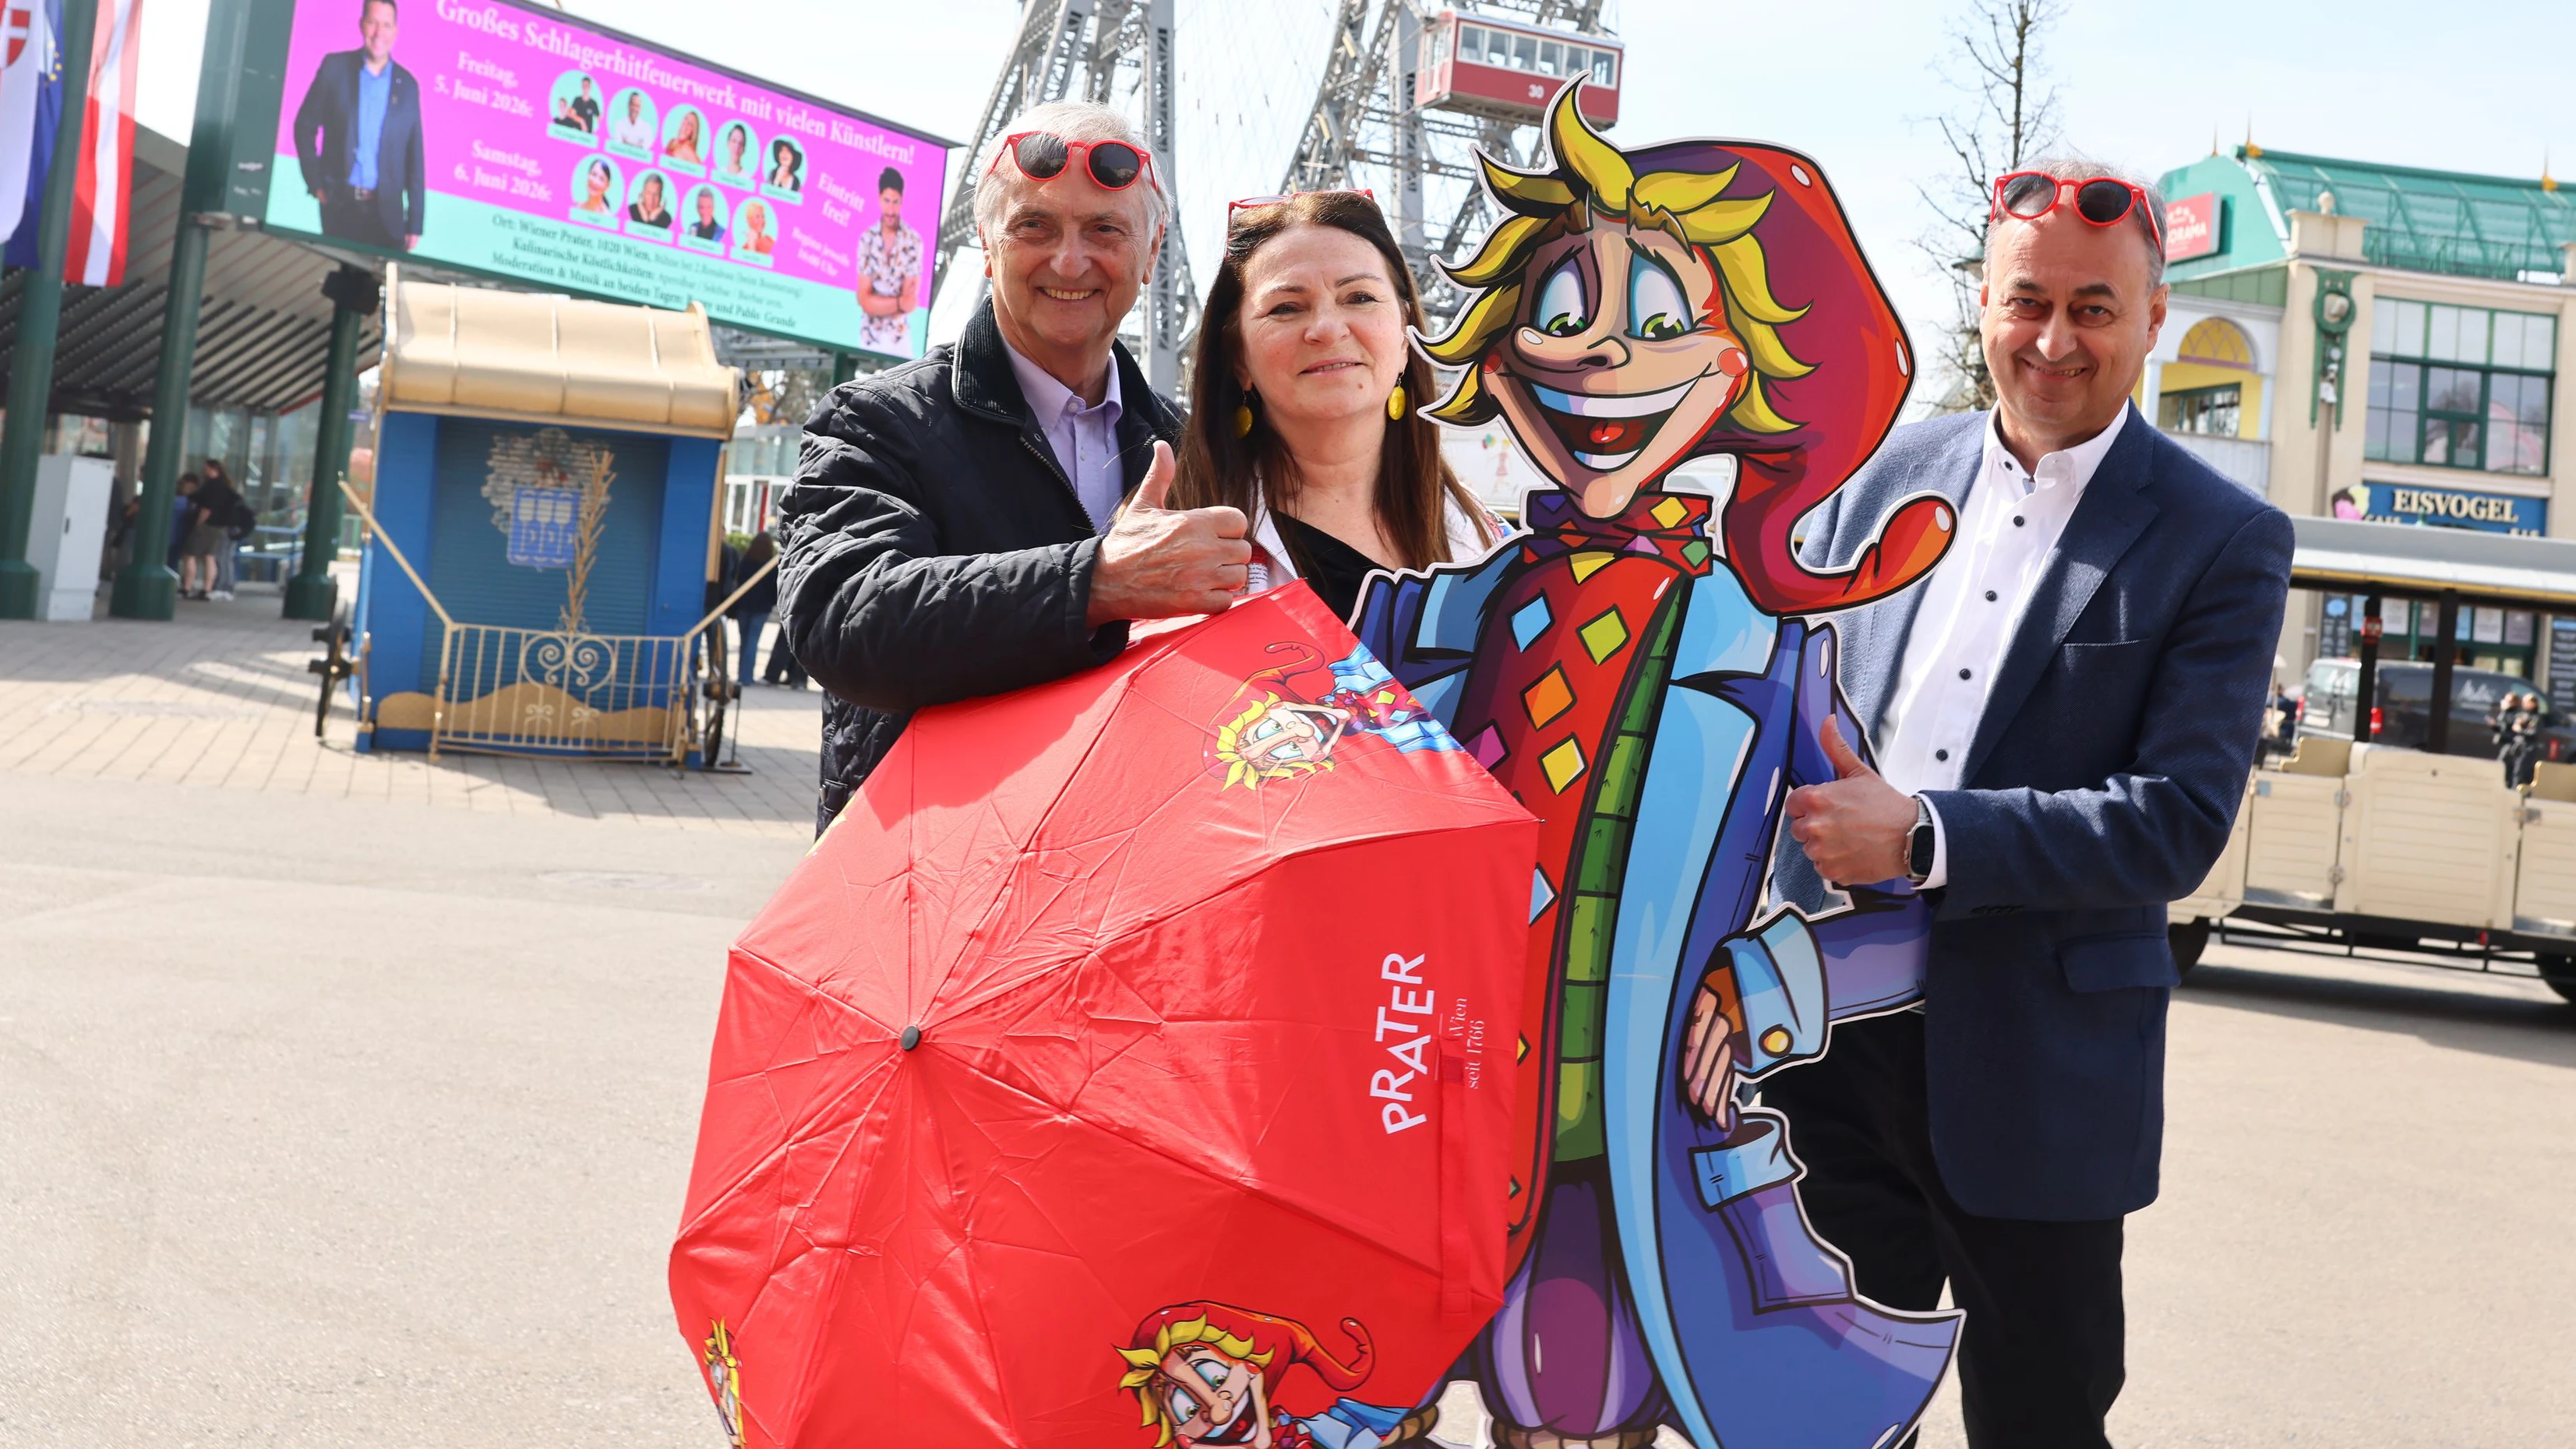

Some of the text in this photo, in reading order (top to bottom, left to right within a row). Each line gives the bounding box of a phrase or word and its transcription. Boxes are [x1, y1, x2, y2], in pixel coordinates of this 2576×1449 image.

[437, 0, 915, 165] Großes Schlagerhitfeuerwerk mit vielen Künstlern!
[457, 51, 519, 89] Freitag,
[434, 74, 534, 118] 5. Juni 2026:
[1528, 83, 1544, 100] 30
[453, 163, 470, 182] 6.
[473, 165, 508, 192] Juni
[471, 139, 542, 178] Samstag,
[818, 172, 865, 213] Eintritt
[822, 199, 851, 227] frei!
[492, 213, 515, 230] Ort:
[519, 218, 557, 240] Wiener
[559, 228, 595, 250] Prater,
[623, 243, 655, 262] Wien,
[512, 237, 580, 263] Kulinarische
[582, 253, 655, 280] Köstlichkeiten:
[492, 252, 555, 277] Moderation
[557, 265, 568, 279] &
[570, 268, 600, 286] Musik
[603, 278, 616, 289] an
[617, 279, 650, 298] beiden
[715, 301, 734, 316] und
[2393, 488, 2519, 524] EISVOGEL
[1448, 997, 1467, 1037] Wien
[1370, 953, 1435, 1135] PRATER
[1465, 1020, 1485, 1089] seit 1766
